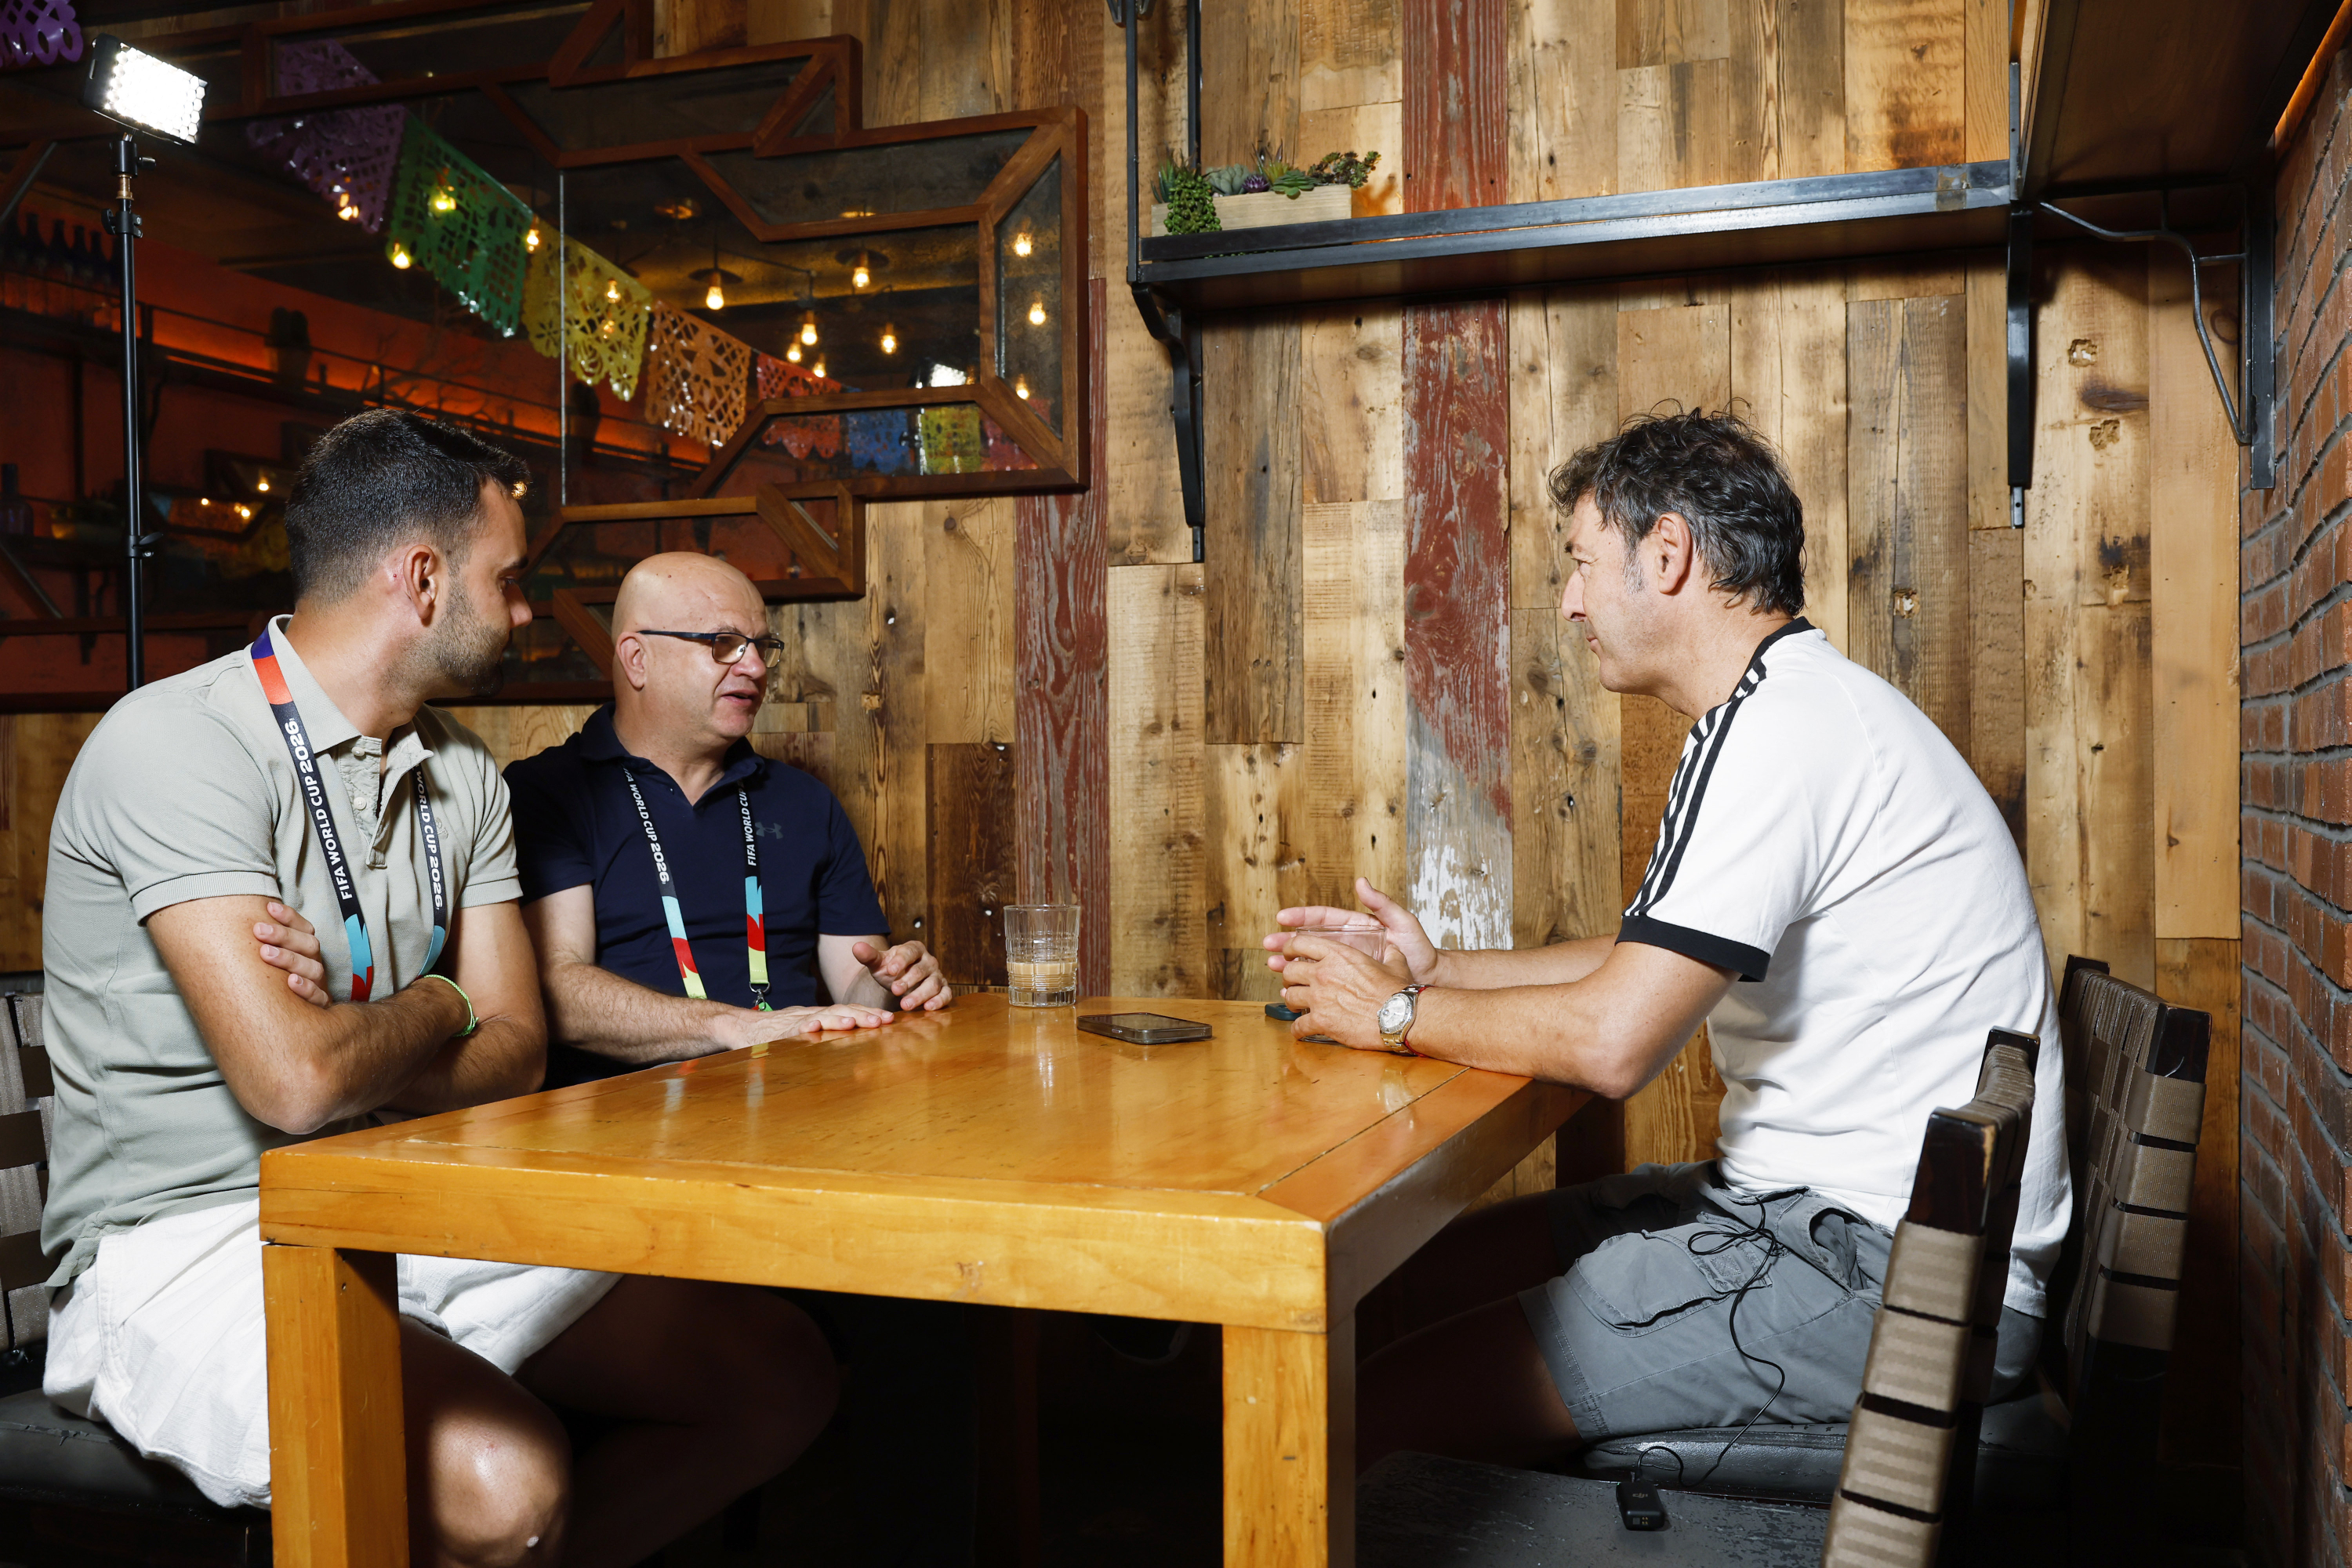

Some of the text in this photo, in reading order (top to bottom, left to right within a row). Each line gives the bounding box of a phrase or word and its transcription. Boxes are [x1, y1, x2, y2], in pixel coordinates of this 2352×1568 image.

[304, 775, 323, 807] CUP
[416, 771, 431, 823] WORLD
[424, 824, 437, 854] CUP
[630, 784, 649, 819] WORLD
[643, 820, 658, 841] CUP
[741, 807, 754, 842] WORLD
[315, 808, 341, 866] WORLD
[746, 844, 757, 866] FIFA
[333, 866, 353, 900] FIFA
